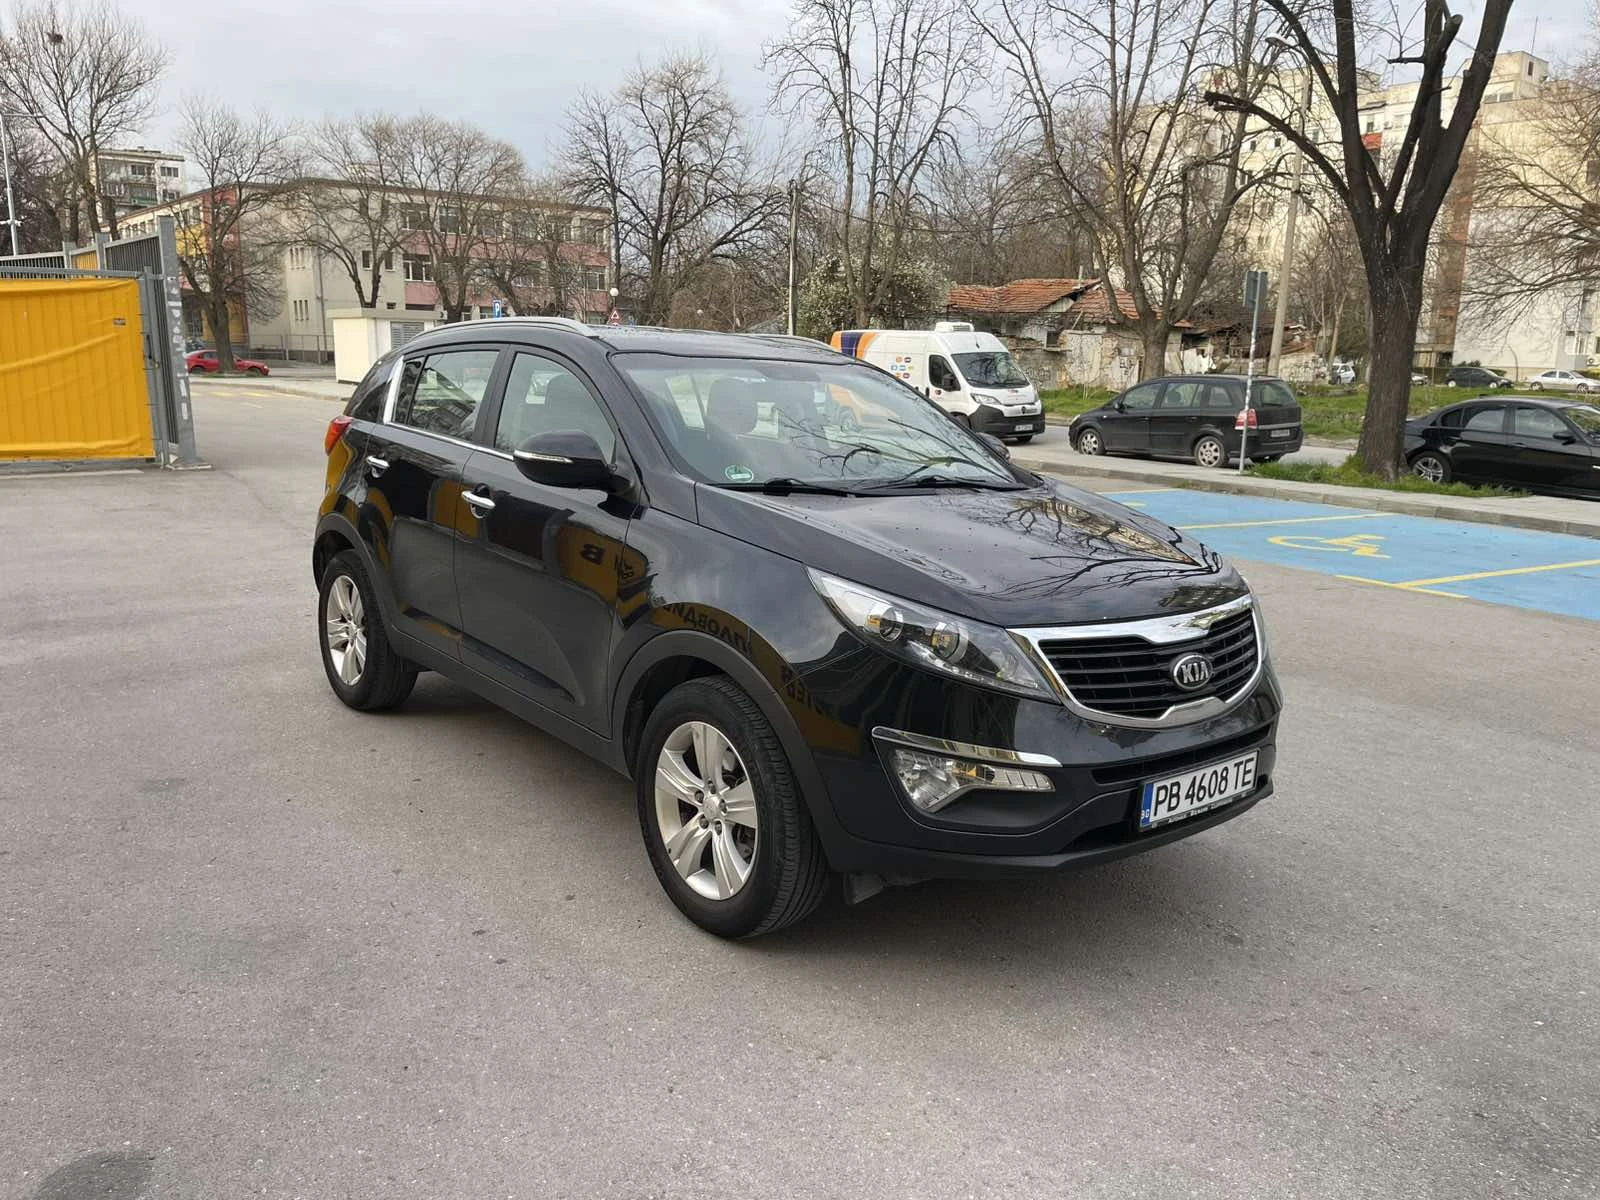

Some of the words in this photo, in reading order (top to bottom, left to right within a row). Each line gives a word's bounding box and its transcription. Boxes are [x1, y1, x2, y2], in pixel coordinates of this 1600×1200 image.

[1181, 661, 1209, 683] KIA
[1154, 781, 1181, 817] PB
[1185, 766, 1229, 805] 4608
[1234, 757, 1255, 790] TE
